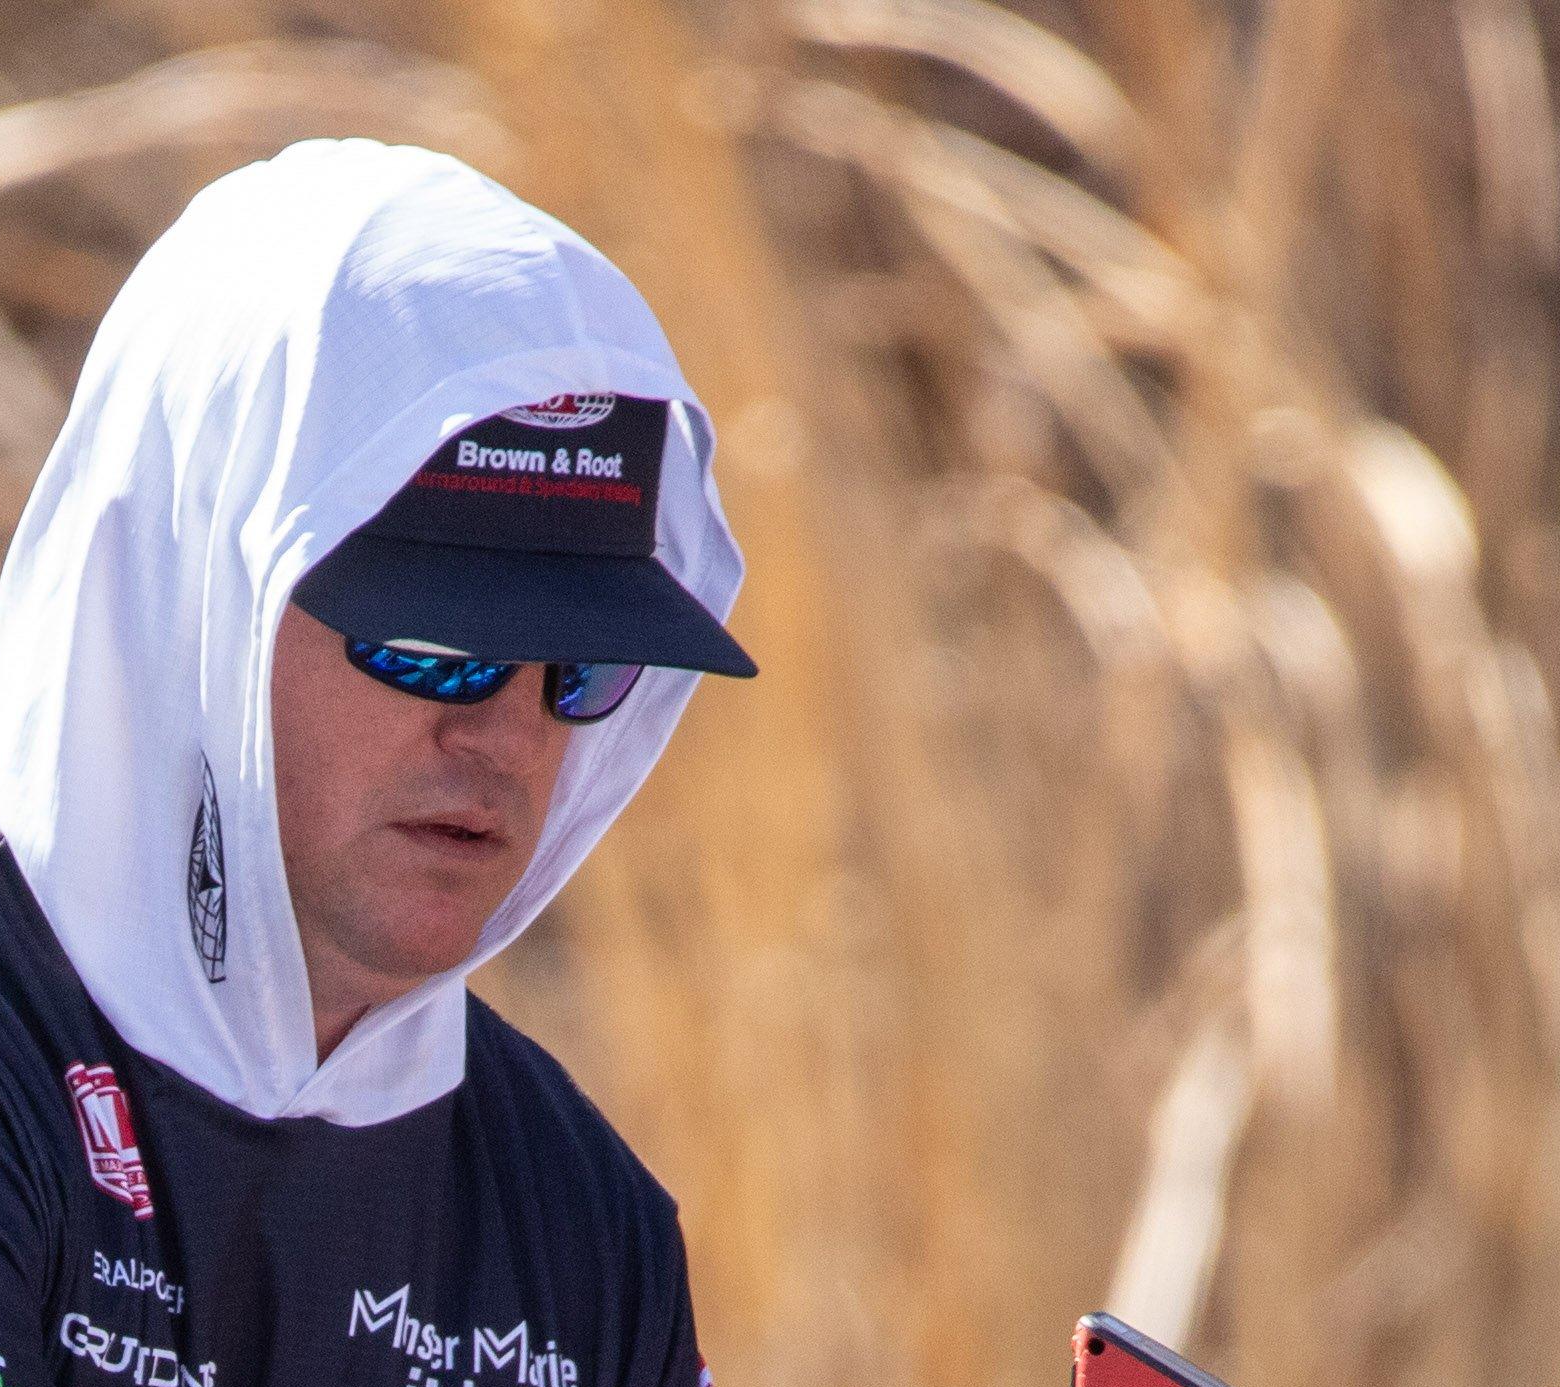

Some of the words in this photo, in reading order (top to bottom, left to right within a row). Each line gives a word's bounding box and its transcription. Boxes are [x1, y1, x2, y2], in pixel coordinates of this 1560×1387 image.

[456, 440, 547, 473] Brown
[551, 448, 572, 476] &
[576, 448, 624, 479] Root
